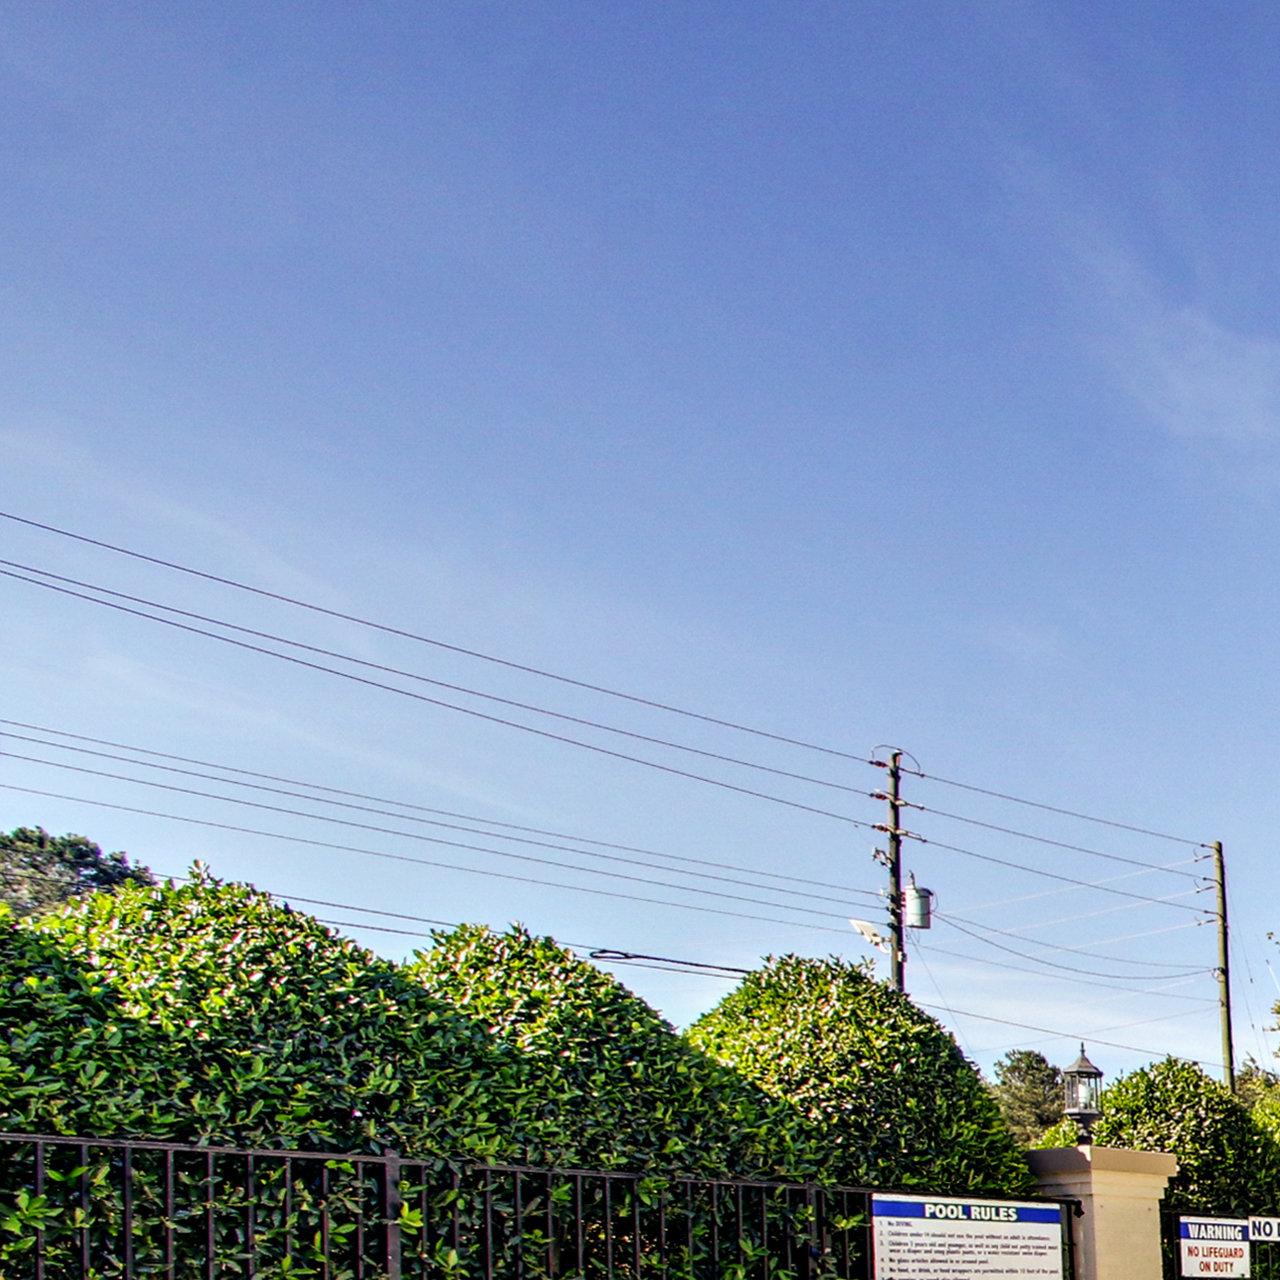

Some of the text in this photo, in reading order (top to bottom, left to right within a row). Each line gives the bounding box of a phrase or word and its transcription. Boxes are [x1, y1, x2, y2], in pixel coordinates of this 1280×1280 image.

[924, 1204, 1018, 1221] POOL RULES
[1188, 1223, 1243, 1240] WARNING
[1252, 1220, 1273, 1237] NO
[1187, 1246, 1244, 1258] NO LIFEGUARD
[1199, 1261, 1234, 1272] ON DUTY
